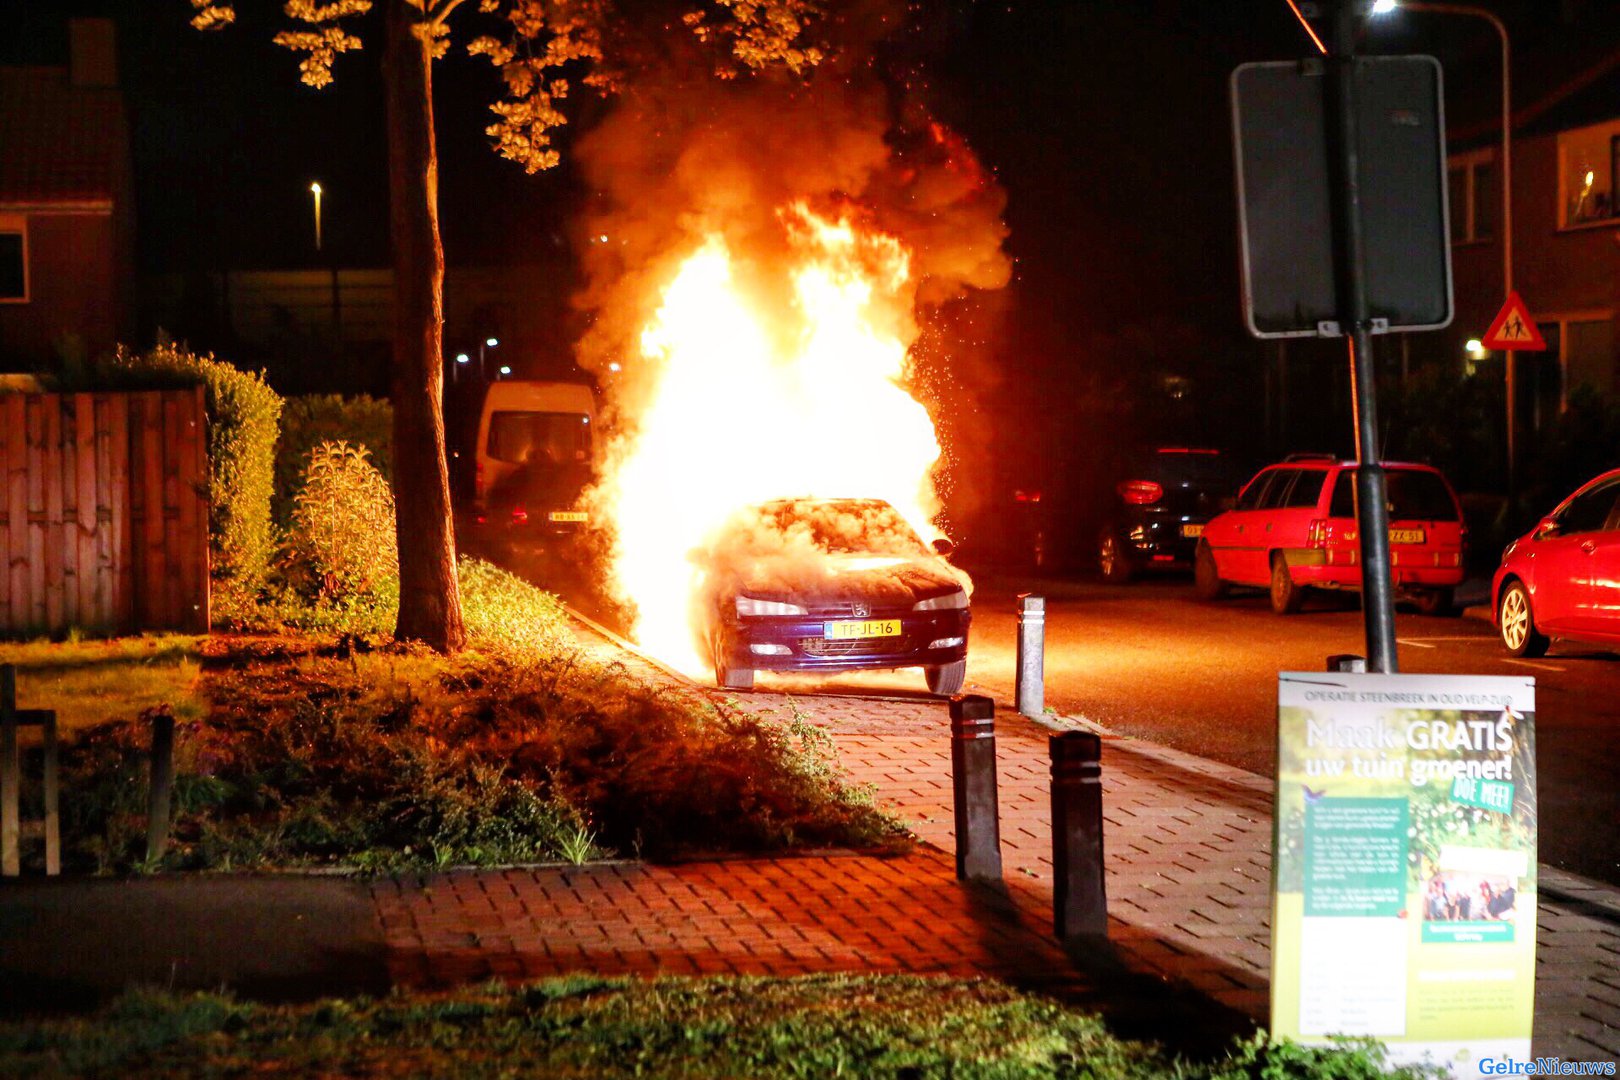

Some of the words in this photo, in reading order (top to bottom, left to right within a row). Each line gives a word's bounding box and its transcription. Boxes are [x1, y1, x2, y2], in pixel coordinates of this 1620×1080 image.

[841, 622, 893, 636] TF-JL-16
[1304, 690, 1356, 702] OPERATIE
[1306, 716, 1394, 750] Maak
[1406, 720, 1513, 751] GRATIS
[1306, 758, 1345, 778] uw
[1352, 752, 1404, 779] tuin
[1410, 754, 1513, 787] groener!
